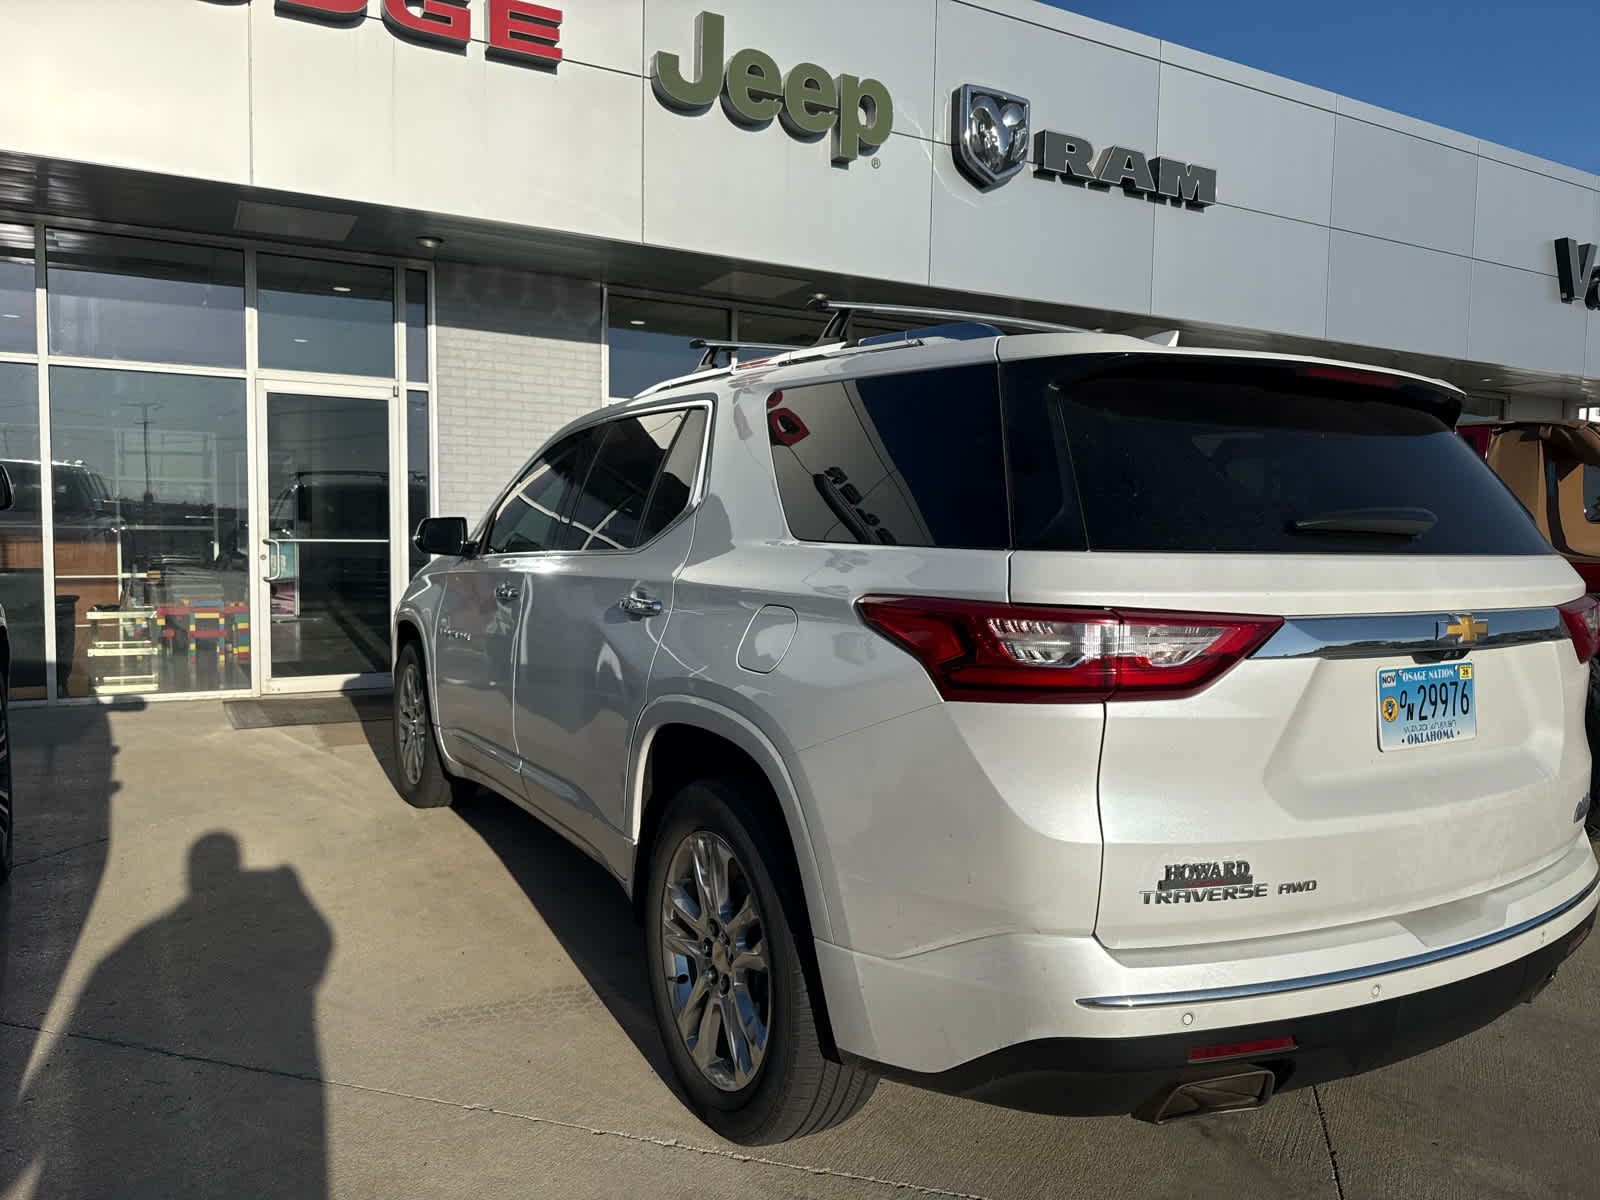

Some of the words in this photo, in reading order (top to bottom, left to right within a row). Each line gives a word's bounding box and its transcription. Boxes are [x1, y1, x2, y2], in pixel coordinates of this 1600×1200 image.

[651, 11, 893, 168] Jeep
[1034, 129, 1217, 212] RAM
[1382, 673, 1396, 684] NOV
[1402, 670, 1427, 682] OSAGE
[1428, 668, 1454, 680] NATION
[1417, 681, 1470, 721] 29976
[1407, 729, 1455, 745] OKLAHOMA
[1164, 860, 1250, 881] HOWARD
[1139, 883, 1268, 905] TRAVERSE
[1277, 880, 1317, 895] AWD
